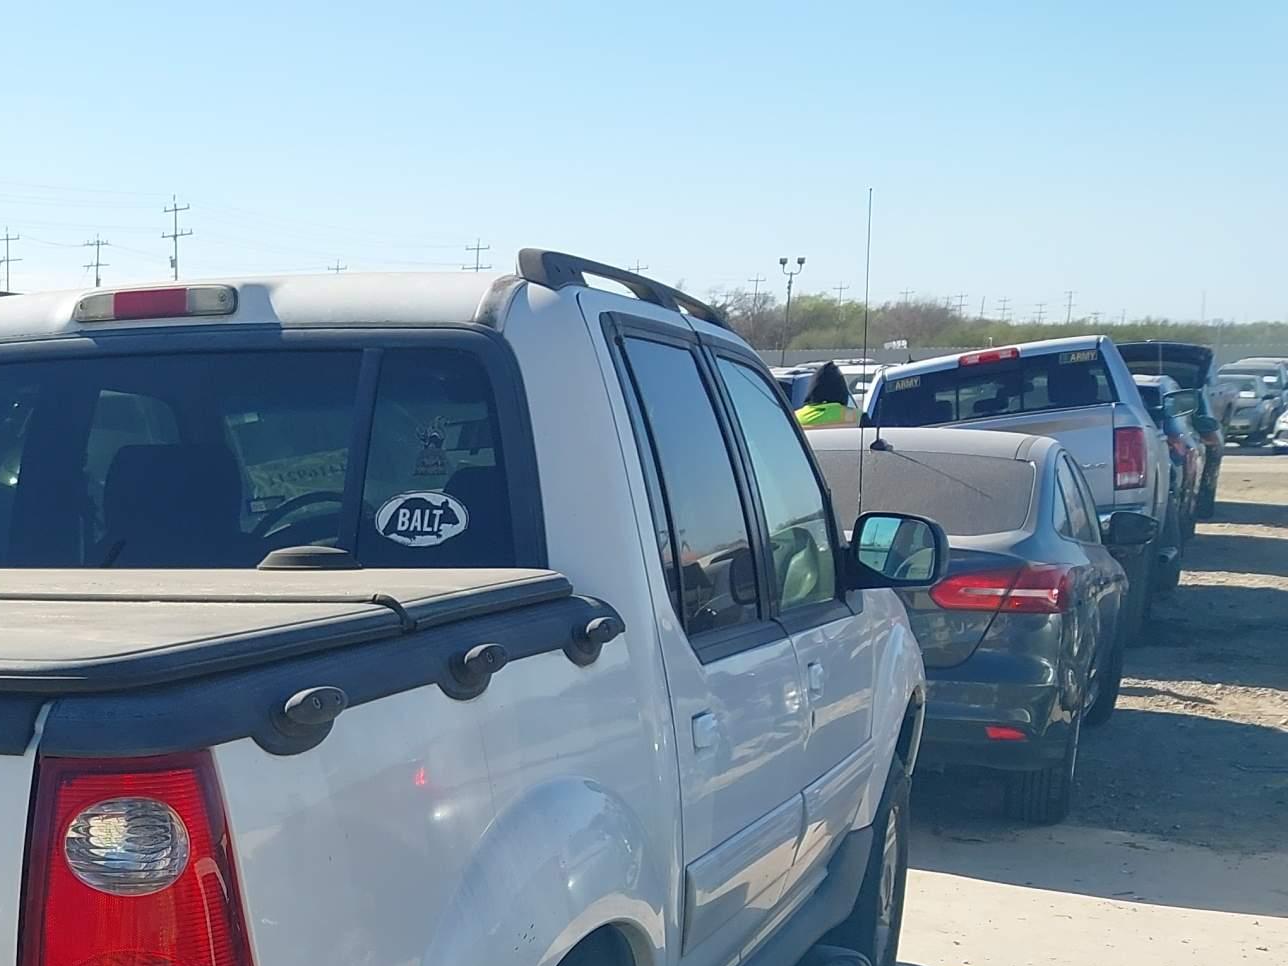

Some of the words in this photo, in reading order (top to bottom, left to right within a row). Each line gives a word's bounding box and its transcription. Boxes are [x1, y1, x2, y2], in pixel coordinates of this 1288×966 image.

[1070, 350, 1097, 362] ARMY
[895, 376, 920, 391] ARMY
[397, 508, 444, 532] BALT
